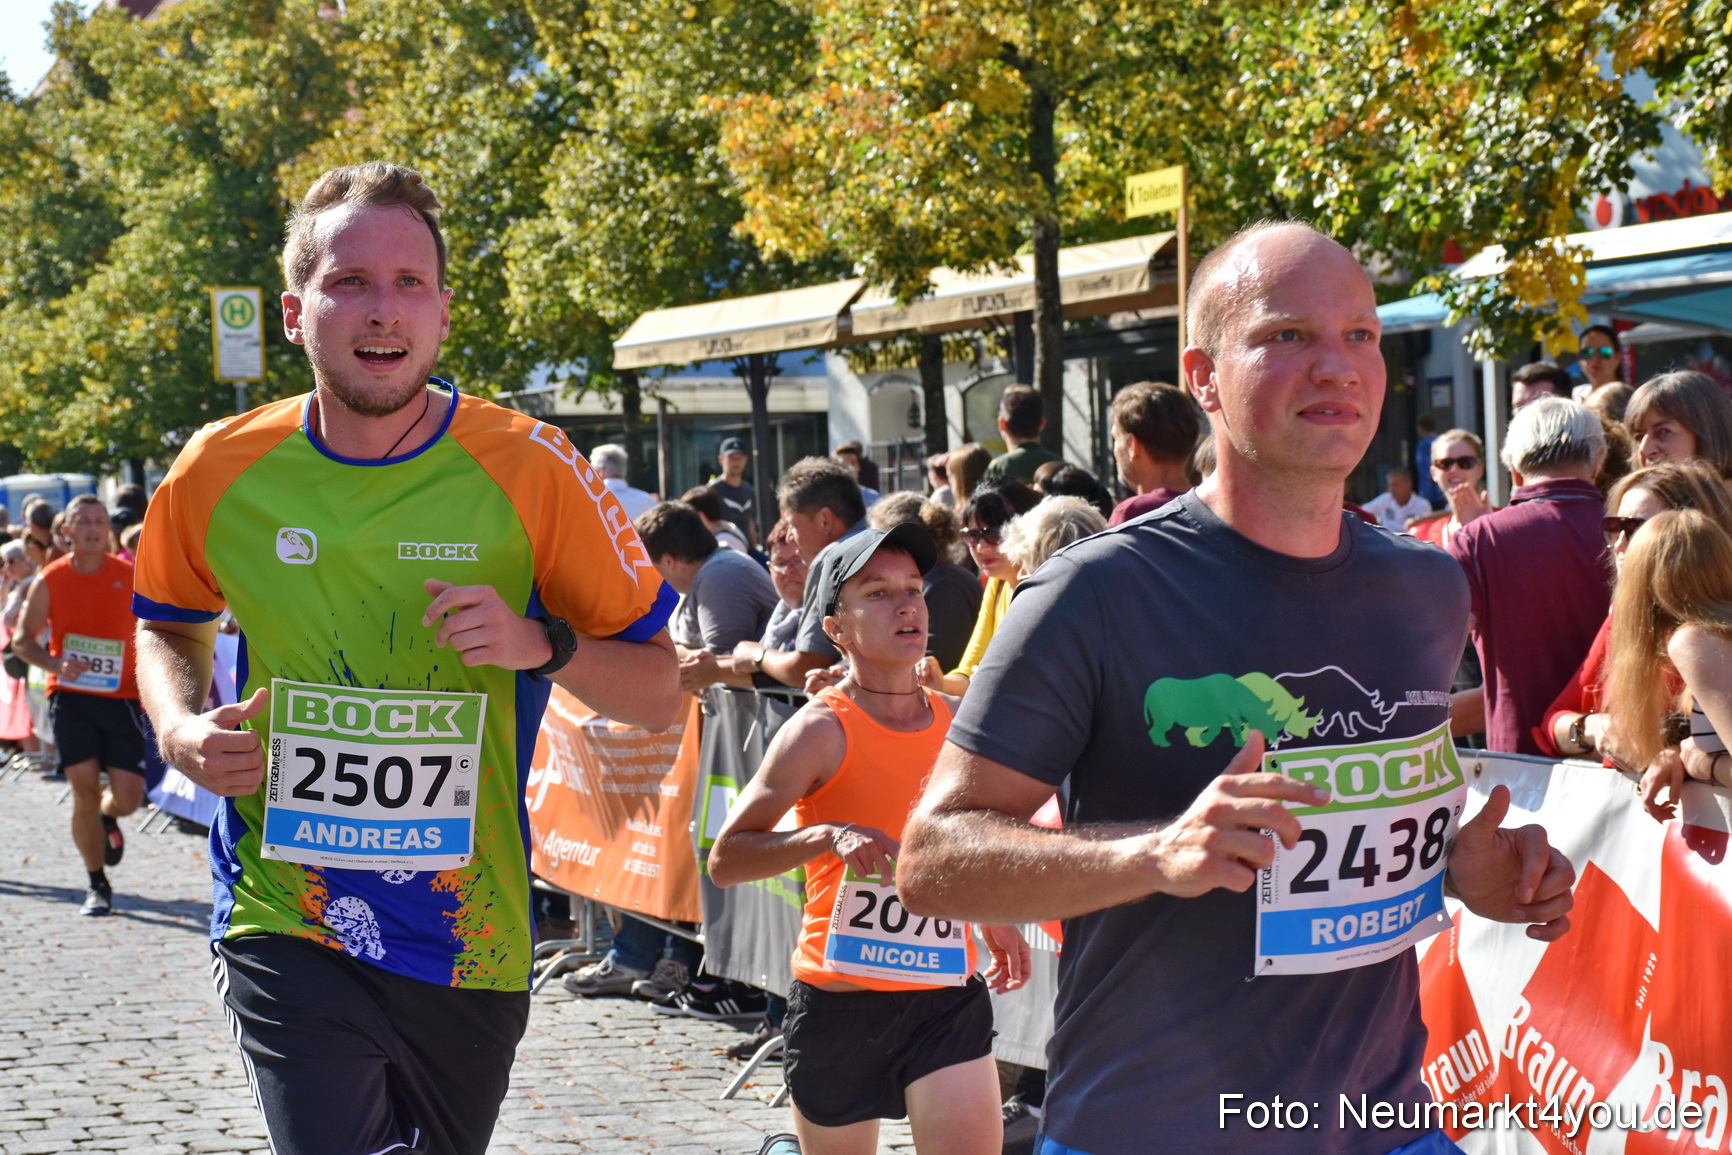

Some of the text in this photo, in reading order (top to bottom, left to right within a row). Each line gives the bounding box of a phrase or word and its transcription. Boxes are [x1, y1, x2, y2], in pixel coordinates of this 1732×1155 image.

[1138, 184, 1179, 204] Toiletten
[1635, 178, 1732, 224] voda
[529, 420, 654, 591] BOCK
[398, 542, 479, 561] BOCK
[69, 638, 117, 655] BOCK
[287, 689, 465, 739] BOCK
[292, 747, 453, 809] 2507
[460, 759, 469, 769] C
[1281, 738, 1456, 806] BOCK
[293, 820, 442, 850] ANDREAS
[544, 829, 602, 868] Agentur
[1290, 807, 1450, 895] 2438
[1311, 893, 1426, 945] ROBERT
[860, 944, 940, 969] NICOLE
[1635, 952, 1658, 1010] Seit 1929
[1421, 1029, 1490, 1102] raun
[1500, 993, 1596, 1127] Braun
[1476, 1082, 1486, 1096] ist
[1632, 1036, 1732, 1151] Bra
